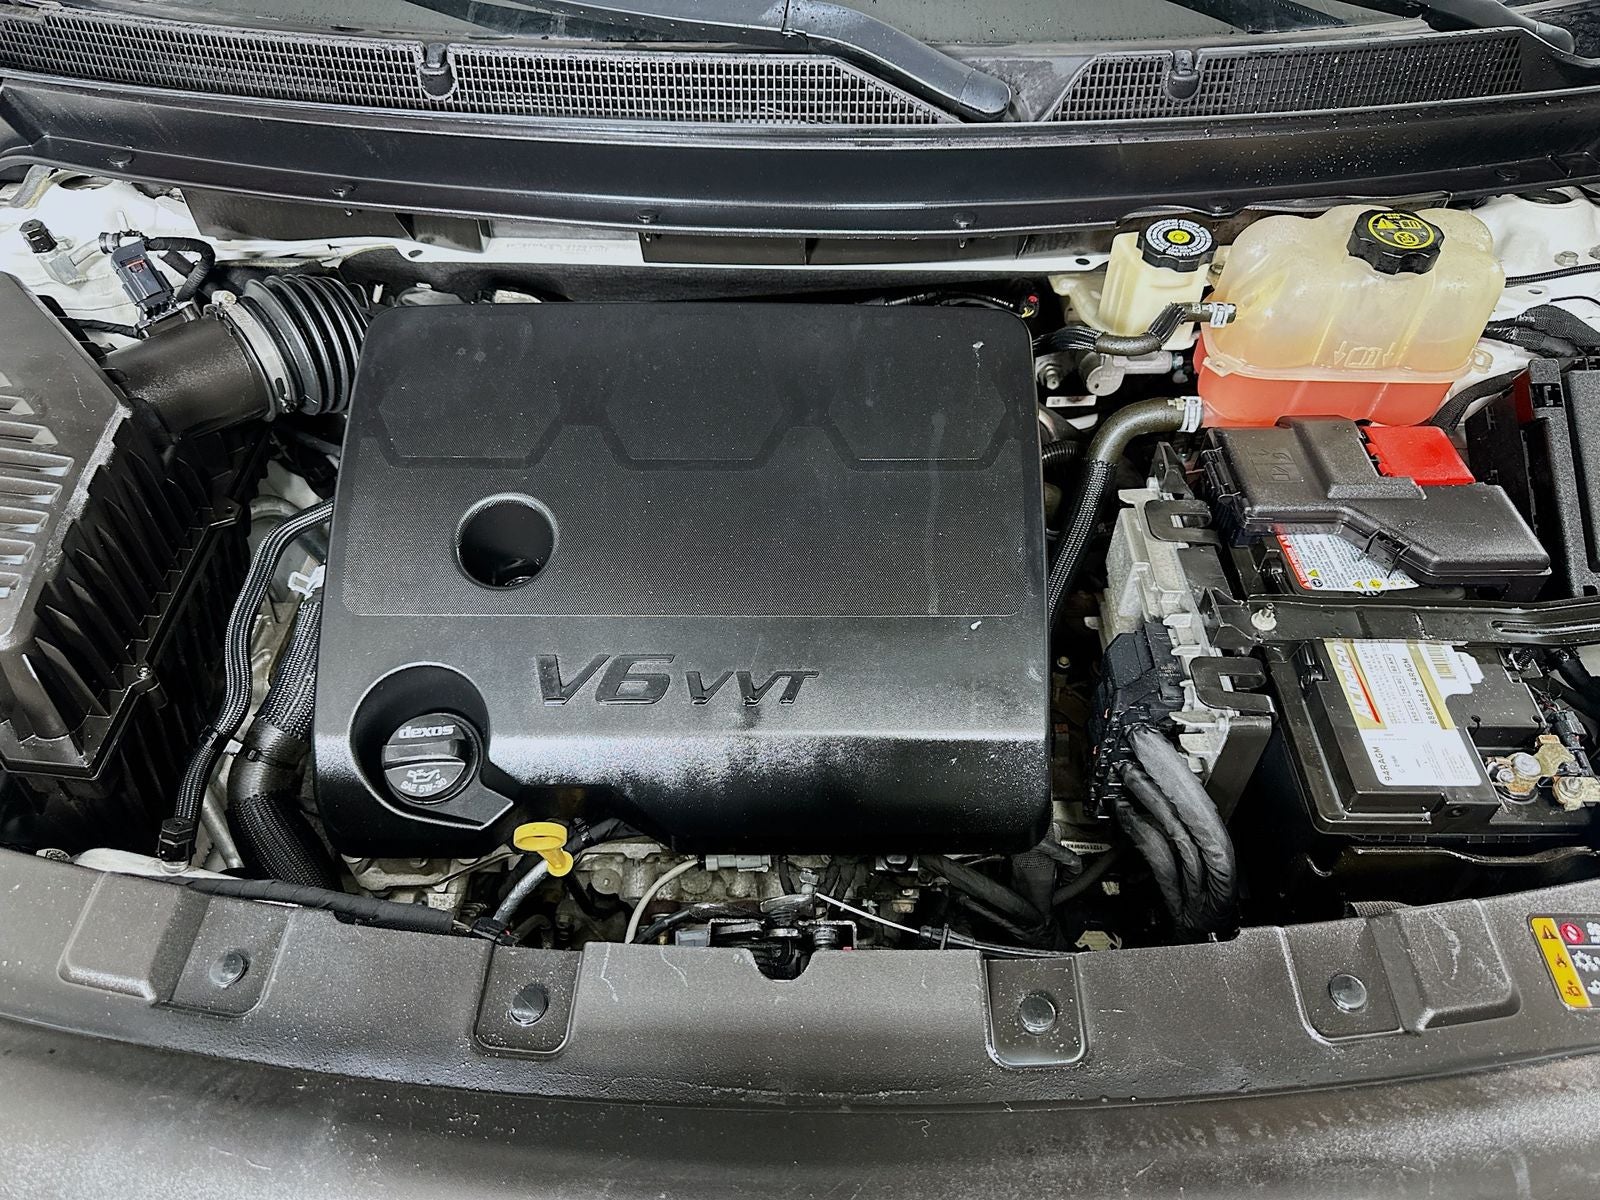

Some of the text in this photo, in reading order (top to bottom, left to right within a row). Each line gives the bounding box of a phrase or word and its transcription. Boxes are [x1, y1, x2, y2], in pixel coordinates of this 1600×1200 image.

[536, 654, 819, 706] V6 VVT
[1402, 658, 1420, 686] 94RAGM
[398, 724, 456, 739] dexos
[1372, 746, 1393, 782] 94RAGM
[400, 777, 448, 793] SAE 5W-30
